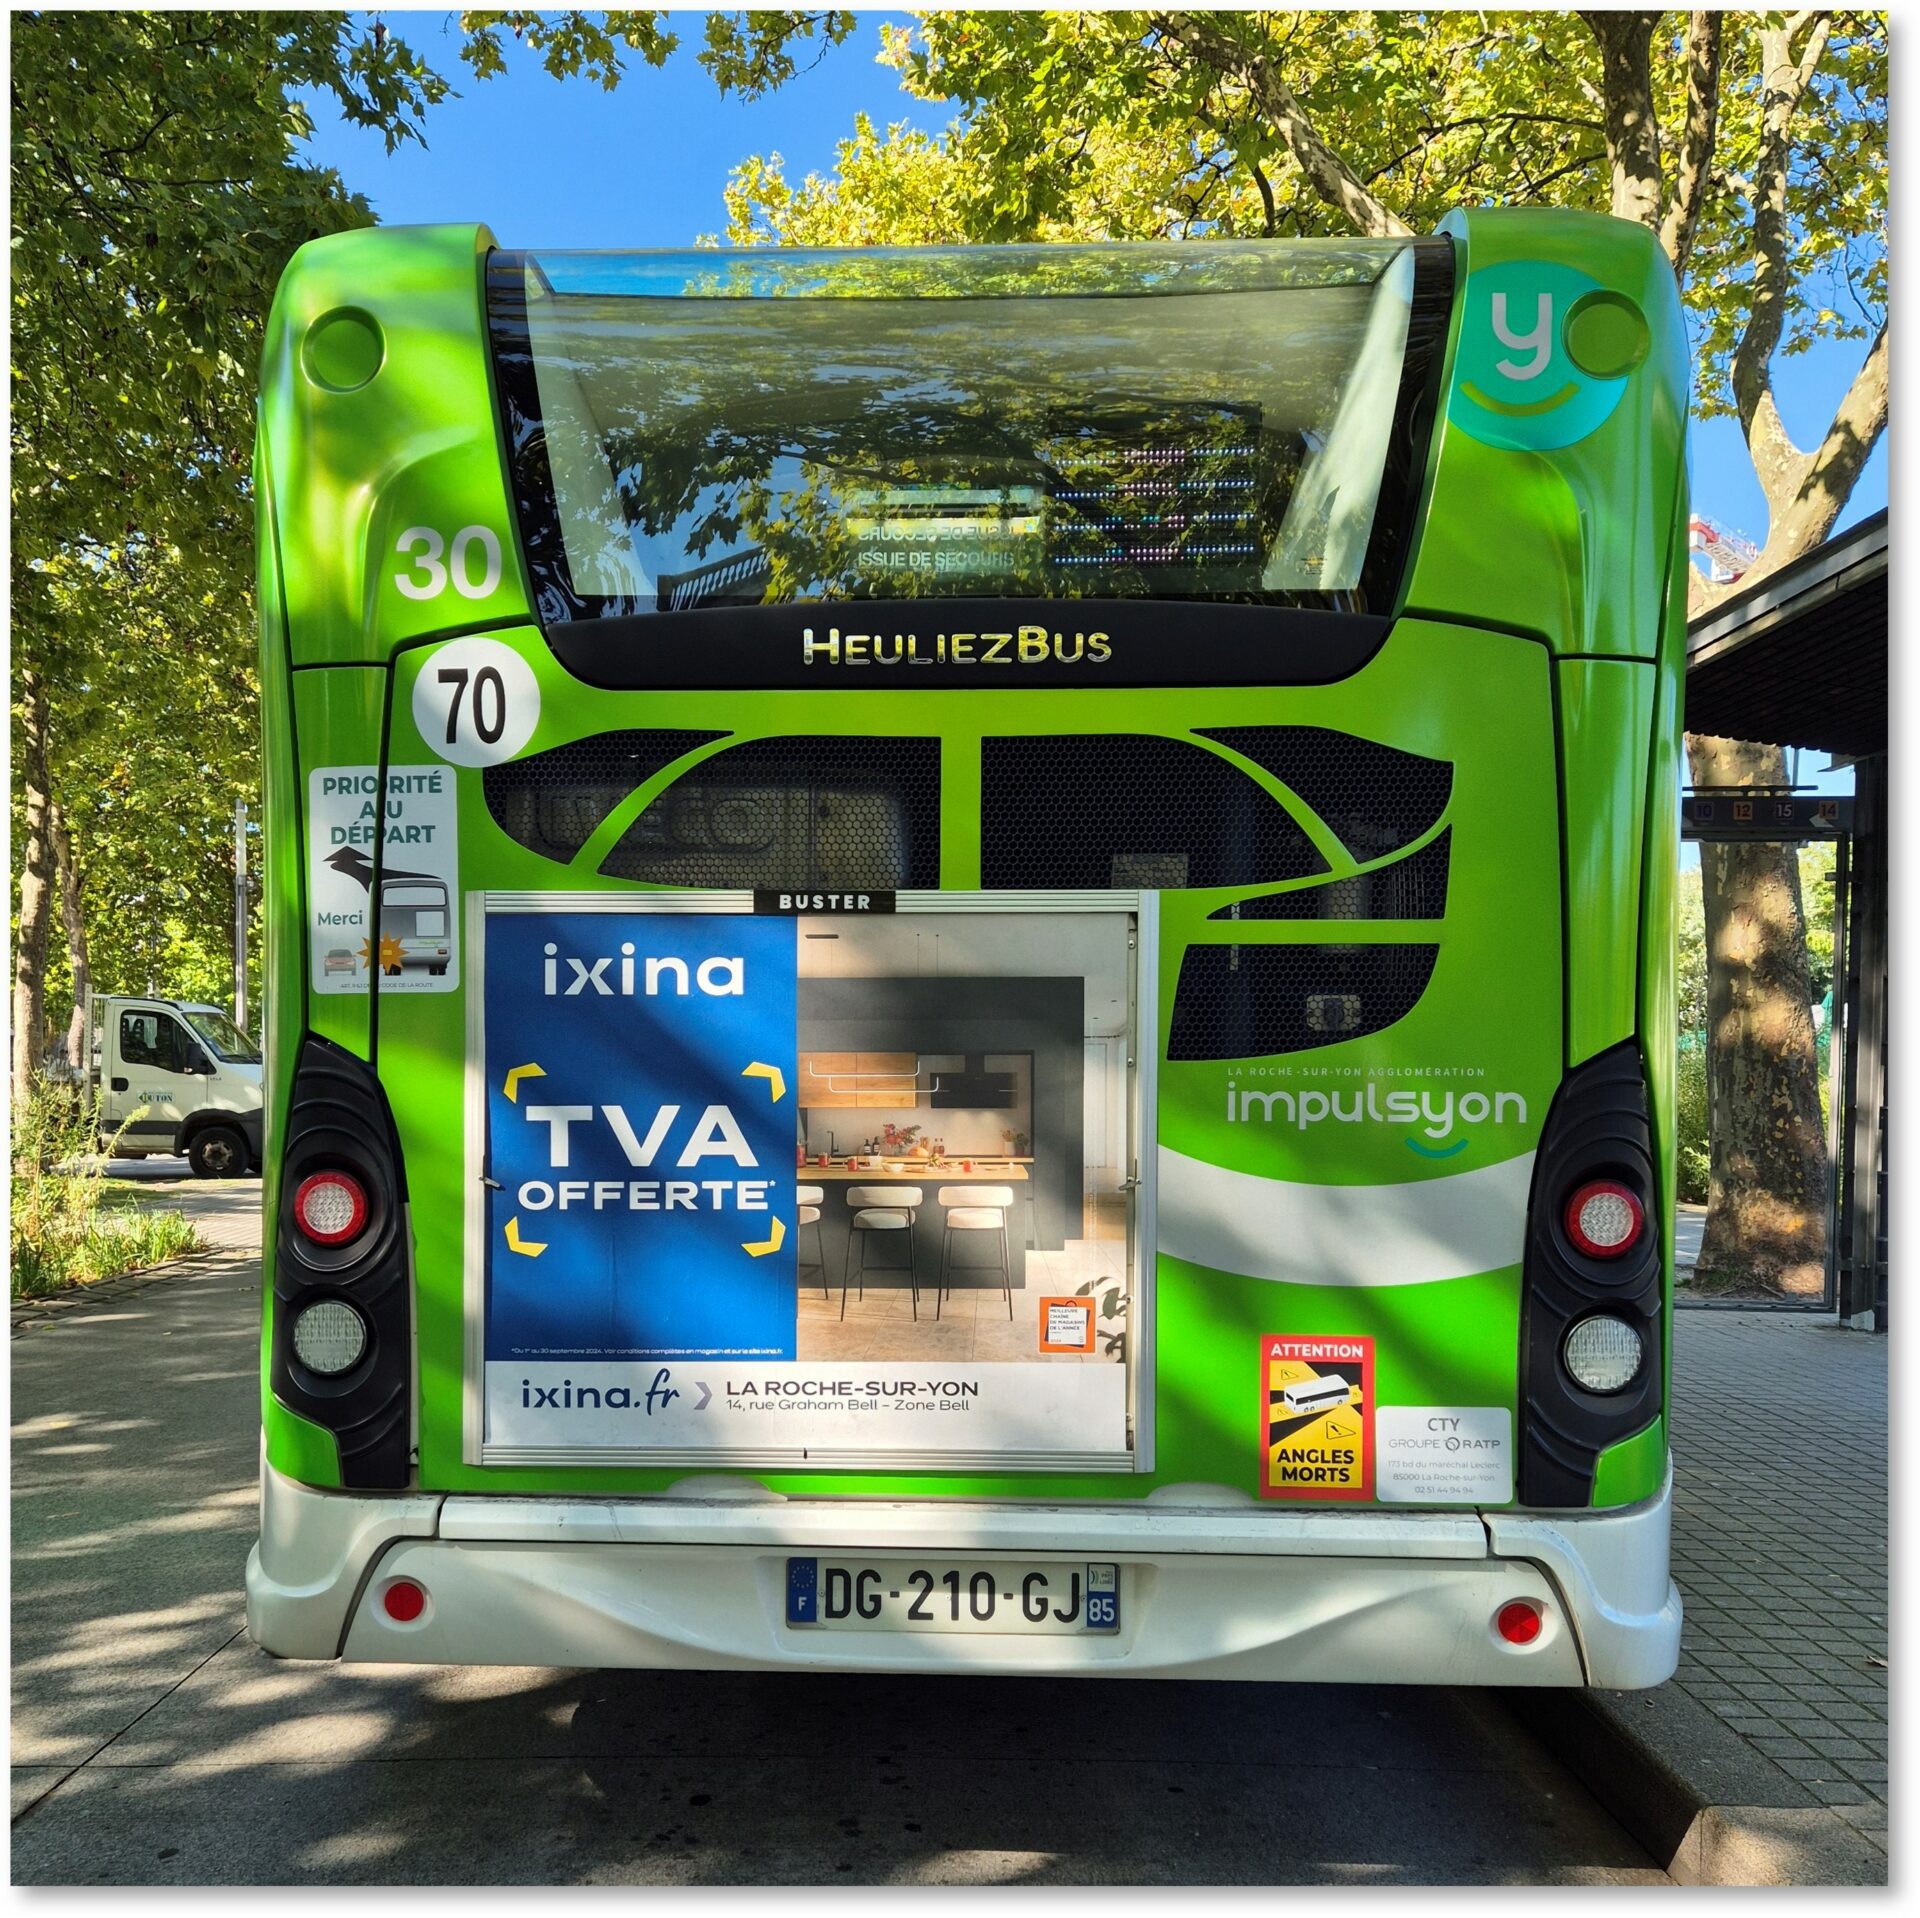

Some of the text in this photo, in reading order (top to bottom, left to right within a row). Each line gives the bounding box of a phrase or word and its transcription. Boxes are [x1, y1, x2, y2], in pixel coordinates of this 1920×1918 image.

[1492, 292, 1553, 381] y
[394, 525, 502, 600] 30
[858, 552, 1015, 567] ISSUE DE SECOURS
[437, 666, 506, 744] 70
[323, 770, 443, 795] PRIORITÉ
[359, 801, 403, 819] AU
[1697, 804, 1711, 818] 10
[1735, 804, 1750, 818] 12
[1776, 803, 1792, 817] 15
[1820, 804, 1836, 817] 14
[331, 821, 436, 844] DÉPART
[779, 894, 870, 909] BUSTER
[317, 910, 363, 926] Merci
[543, 942, 745, 995] ixina
[1227, 1067, 1243, 1077] LA
[1367, 1065, 1485, 1078] AGGLOMÉRATION
[1227, 1081, 1527, 1138] impulsyon
[525, 1105, 759, 1168] TVA
[1270, 1343, 1364, 1358] ATTENTION
[522, 1368, 681, 1416] ixina.fr
[726, 1381, 979, 1397] LA ROCHE-SUR-YON
[726, 1399, 746, 1412] 14,
[749, 1401, 774, 1411] rue
[778, 1399, 844, 1411] Graham
[848, 1399, 878, 1411] Bell
[894, 1399, 936, 1411] Zone
[939, 1399, 969, 1411] Bell
[1427, 1417, 1461, 1432] CTY
[1388, 1439, 1501, 1449] GROUPE RATP
[1277, 1449, 1355, 1464] ANGLES
[1402, 1460, 1414, 1468] bd
[1415, 1460, 1427, 1468] du
[1429, 1460, 1468, 1469] maréchal
[1470, 1461, 1501, 1469] Leclerc
[1281, 1466, 1351, 1483] MORTS
[1393, 1473, 1420, 1481] 85000
[1421, 1473, 1432, 1481] La
[1414, 1486, 1474, 1494] 02 51 44 94 94
[797, 1596, 807, 1612] F
[1088, 1598, 1116, 1623] 85
